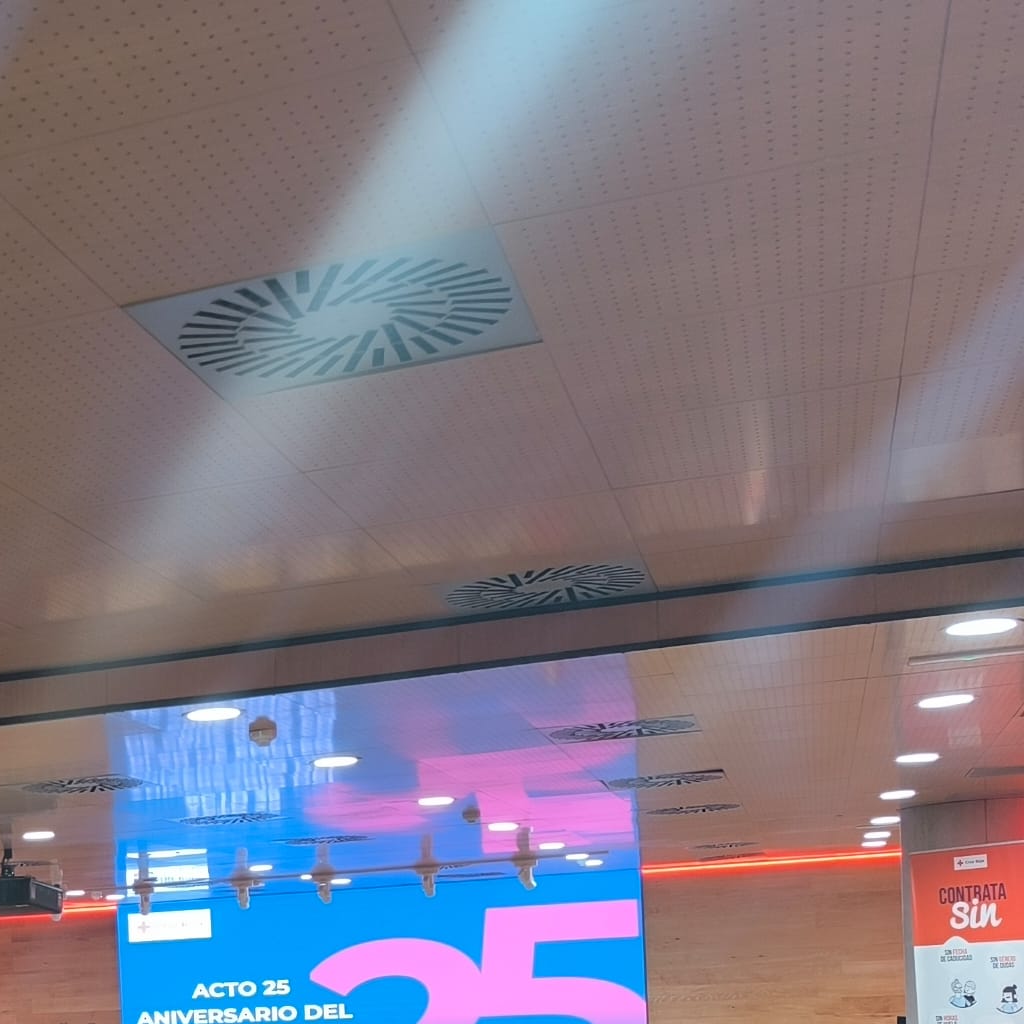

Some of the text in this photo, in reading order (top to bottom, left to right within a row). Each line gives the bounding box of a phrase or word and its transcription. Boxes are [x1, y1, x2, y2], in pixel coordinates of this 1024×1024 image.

[939, 883, 1007, 904] CONTRATA
[950, 898, 1002, 930] Sin
[192, 979, 291, 999] ACTO 25
[304, 1003, 353, 1021] DEL
